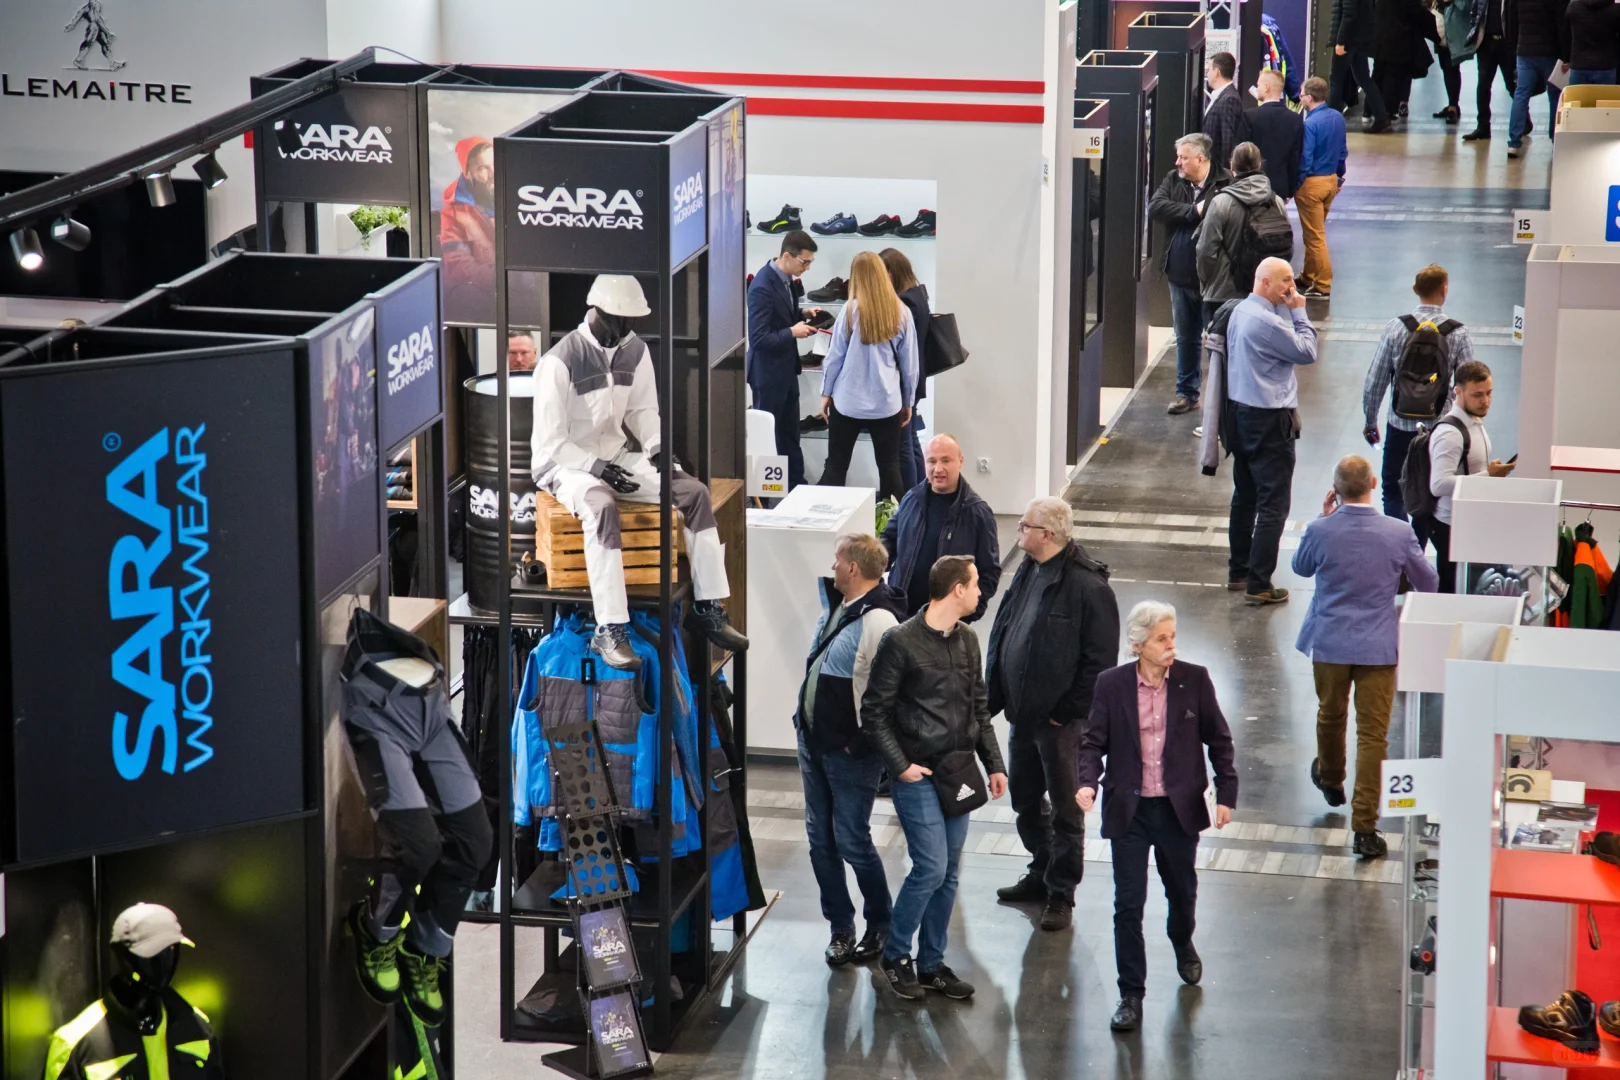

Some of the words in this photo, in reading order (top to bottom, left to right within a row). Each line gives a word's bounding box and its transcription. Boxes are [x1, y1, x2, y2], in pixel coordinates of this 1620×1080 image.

[2, 74, 192, 104] LEMAITRE
[1089, 136, 1101, 147] 16
[517, 185, 644, 216] SARA
[674, 171, 703, 212] SARA
[517, 212, 644, 230] WORKWEAR
[1518, 219, 1531, 231] 15
[1514, 315, 1523, 330] 23
[387, 325, 434, 379] SARA
[387, 354, 434, 396] WORKWEAR
[764, 466, 783, 481] 29
[106, 426, 178, 781] SARA
[175, 422, 214, 773] WORKWEAR
[1389, 774, 1414, 794] 23
[592, 941, 626, 955] SARA
[600, 1026, 634, 1041] SARA
